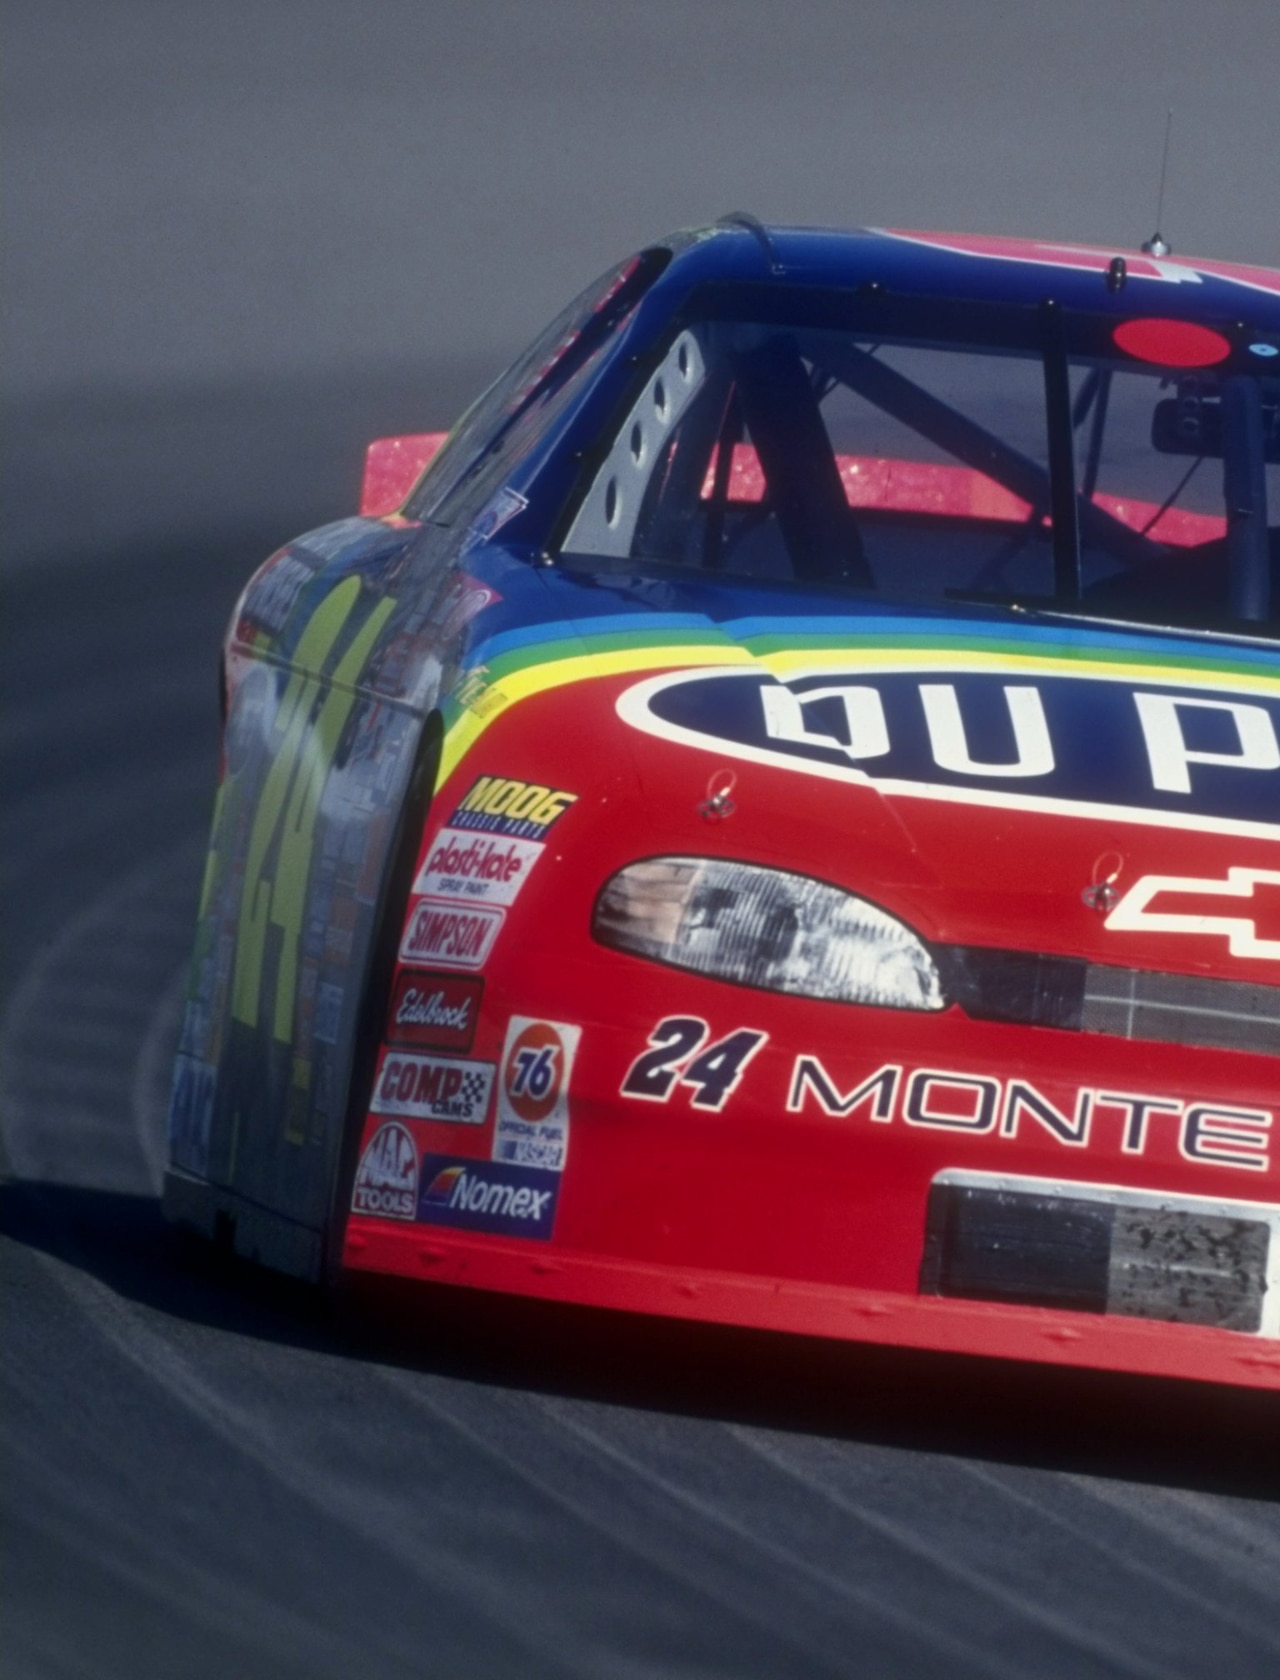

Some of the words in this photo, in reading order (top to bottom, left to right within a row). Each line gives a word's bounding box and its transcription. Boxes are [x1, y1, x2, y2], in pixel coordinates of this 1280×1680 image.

[760, 684, 1055, 776] DU
[458, 776, 579, 825] MOOG
[425, 837, 522, 882] plasti-kote
[407, 911, 493, 957] SIMPSON
[396, 988, 471, 1030] Edelbrock
[381, 1061, 463, 1105] COMP
[512, 1045, 559, 1098] 76
[620, 1015, 768, 1112] 24
[431, 1100, 474, 1118] CAMS
[786, 1055, 1273, 1173] MONTE
[360, 1129, 415, 1191] MAC
[357, 1186, 414, 1213] TOOLS
[450, 1172, 551, 1220] Nomex
